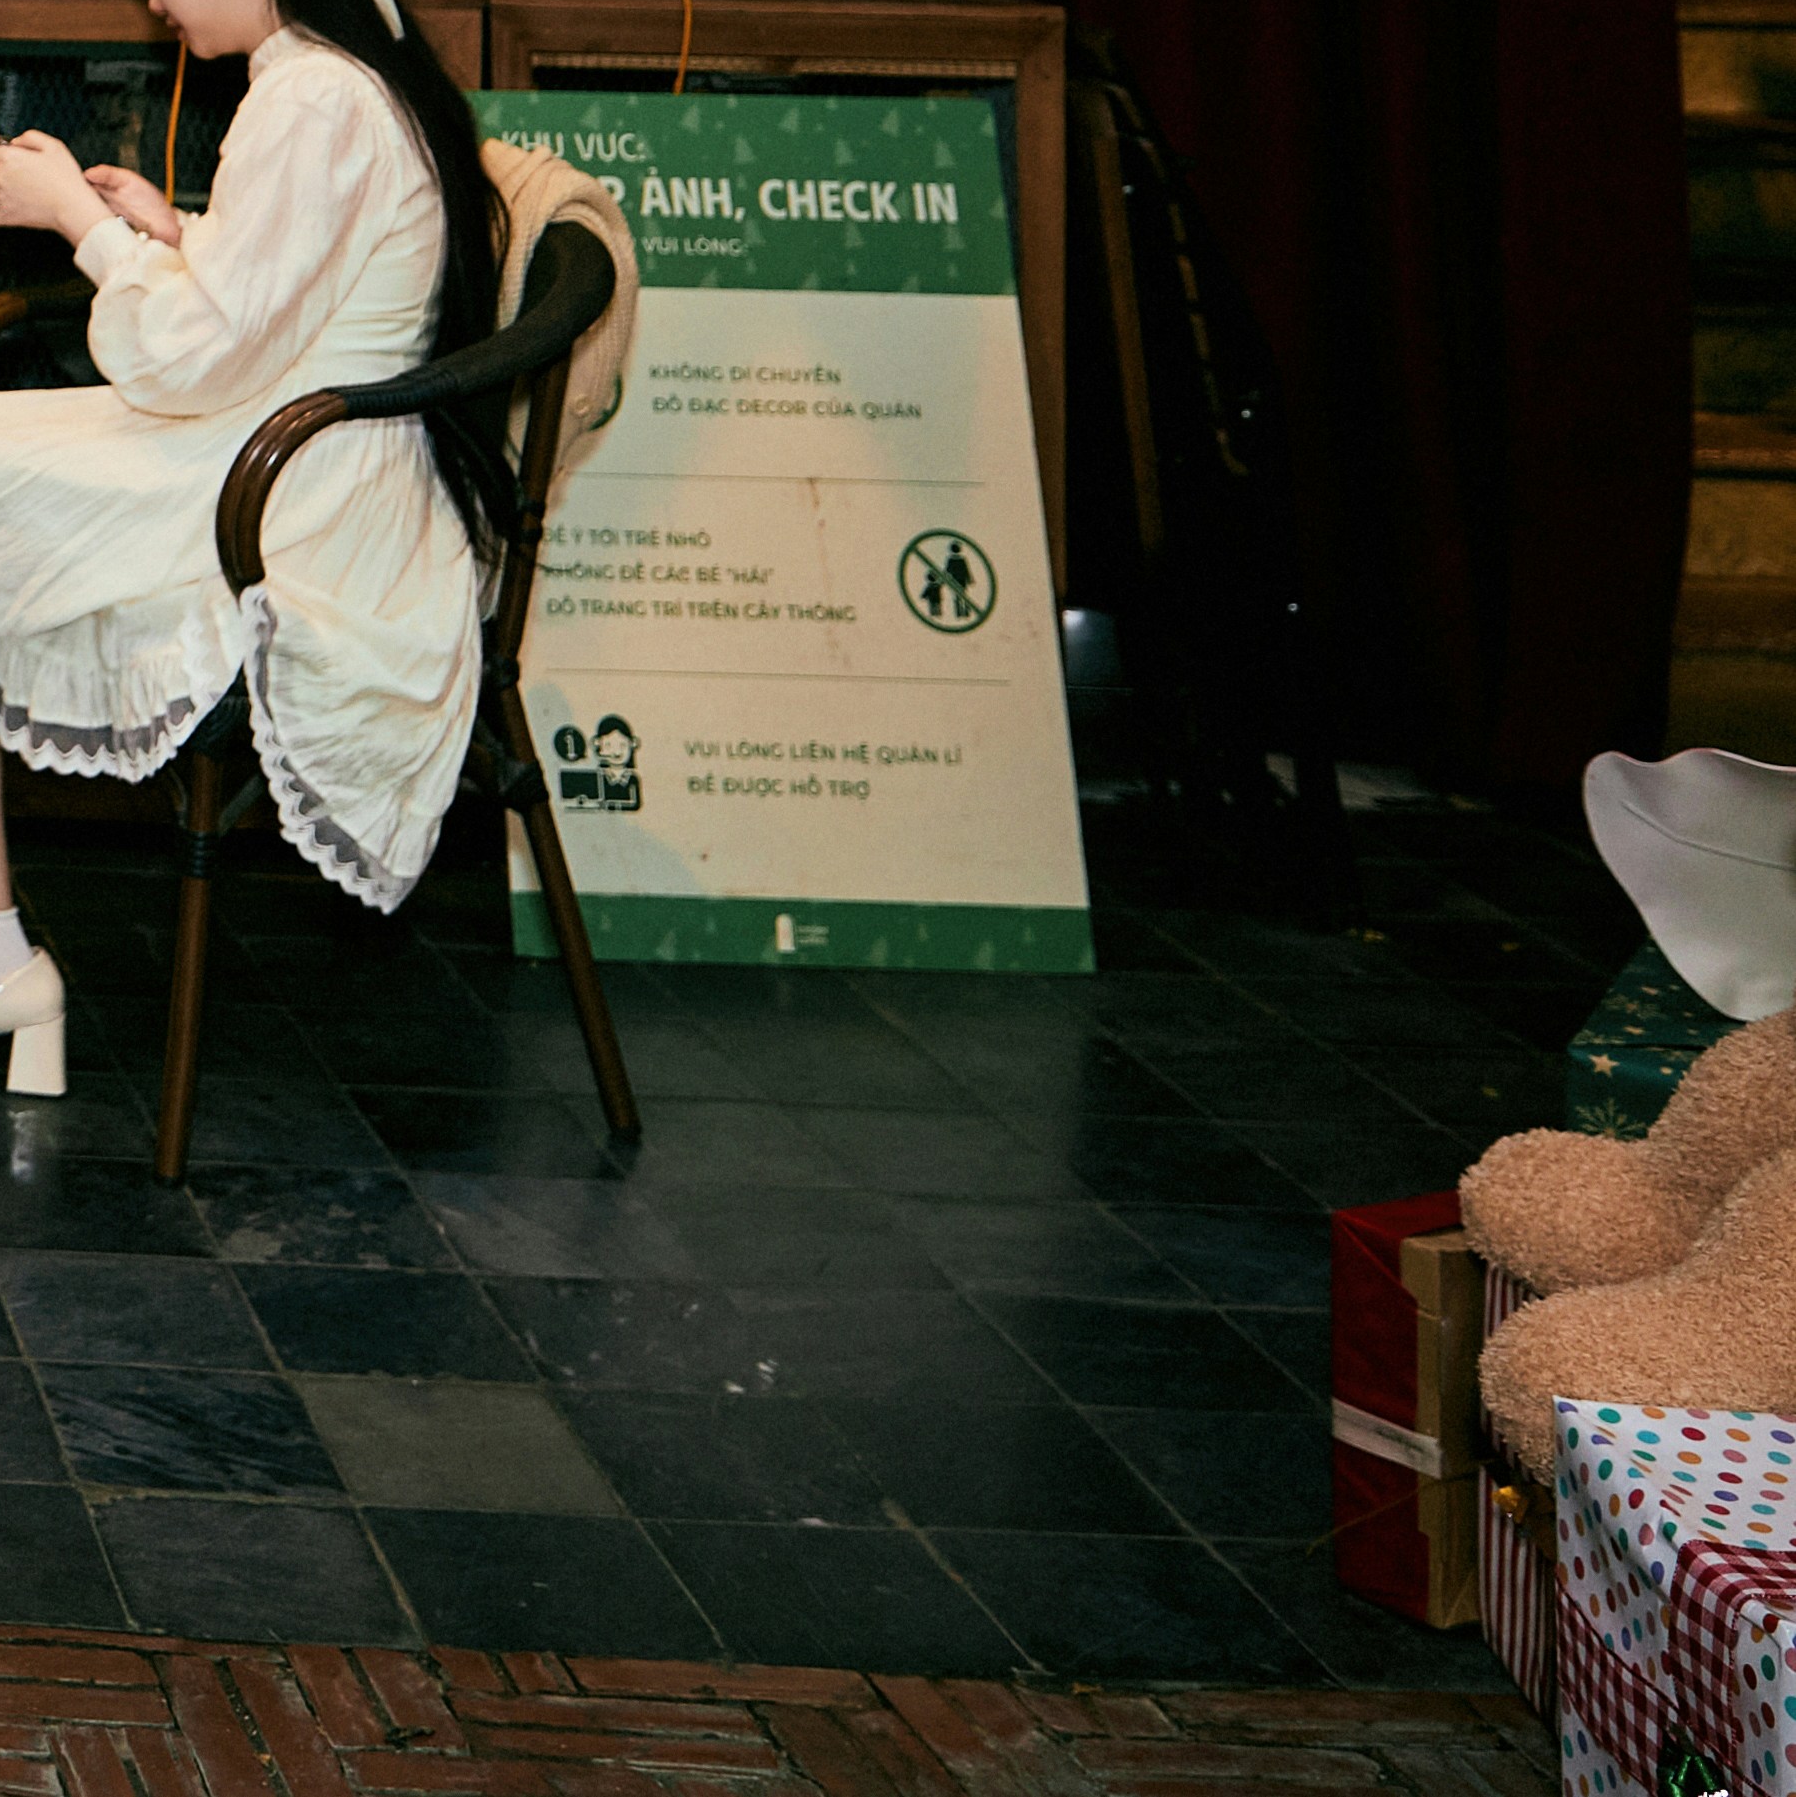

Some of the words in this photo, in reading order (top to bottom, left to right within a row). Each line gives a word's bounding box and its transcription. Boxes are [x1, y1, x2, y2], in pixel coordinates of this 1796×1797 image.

[640, 166, 747, 222] ẢNH,
[758, 178, 902, 222] CHECK
[912, 182, 959, 224] IN
[642, 236, 680, 254] VUI
[649, 362, 724, 382] KHÔNG
[684, 741, 720, 758] VUI
